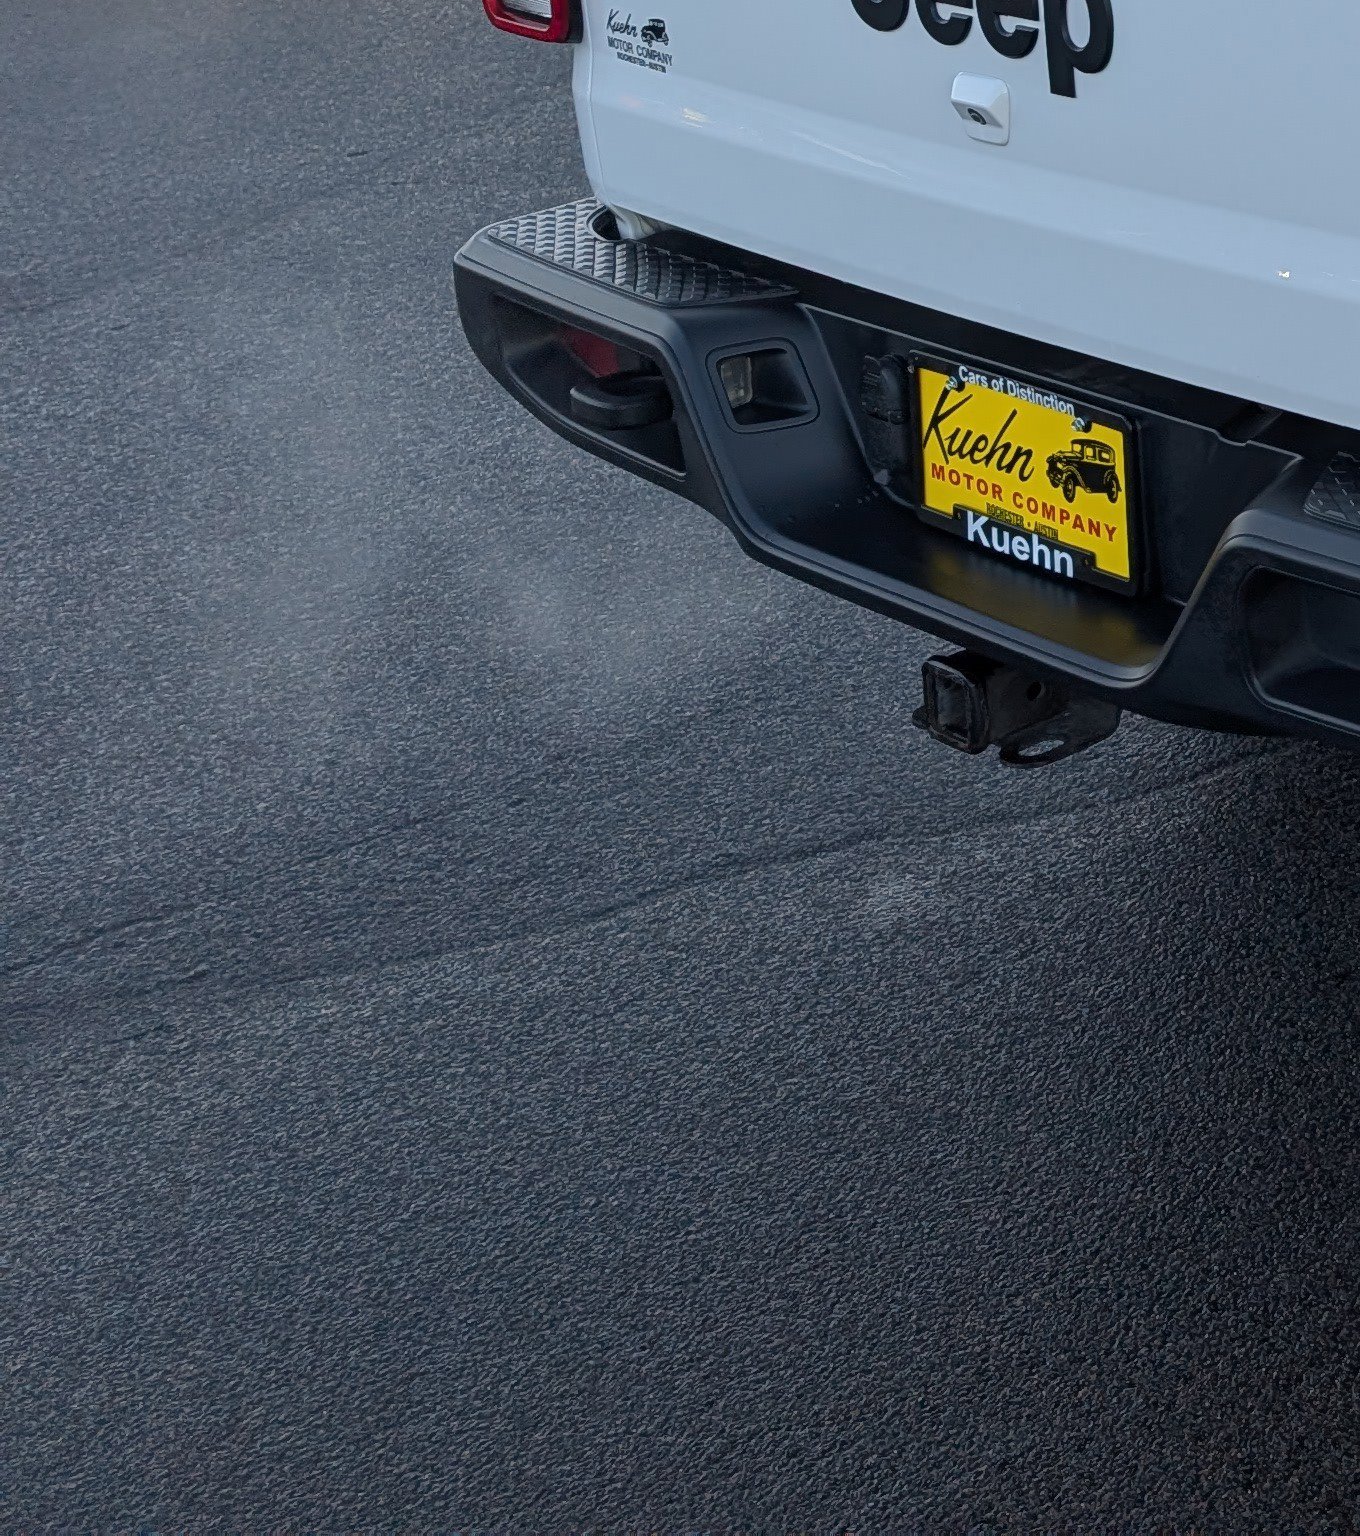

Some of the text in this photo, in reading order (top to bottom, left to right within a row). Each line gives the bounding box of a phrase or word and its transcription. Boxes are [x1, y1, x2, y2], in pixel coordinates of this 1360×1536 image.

[606, 9, 638, 38] Kuehn
[607, 35, 672, 67] MOTOR COMPANY
[958, 365, 1075, 416] Cars of Distinction
[922, 386, 1035, 482] Kuehn
[931, 463, 1118, 542] MOTOR COMPANY
[966, 510, 1074, 579] Kuehn
